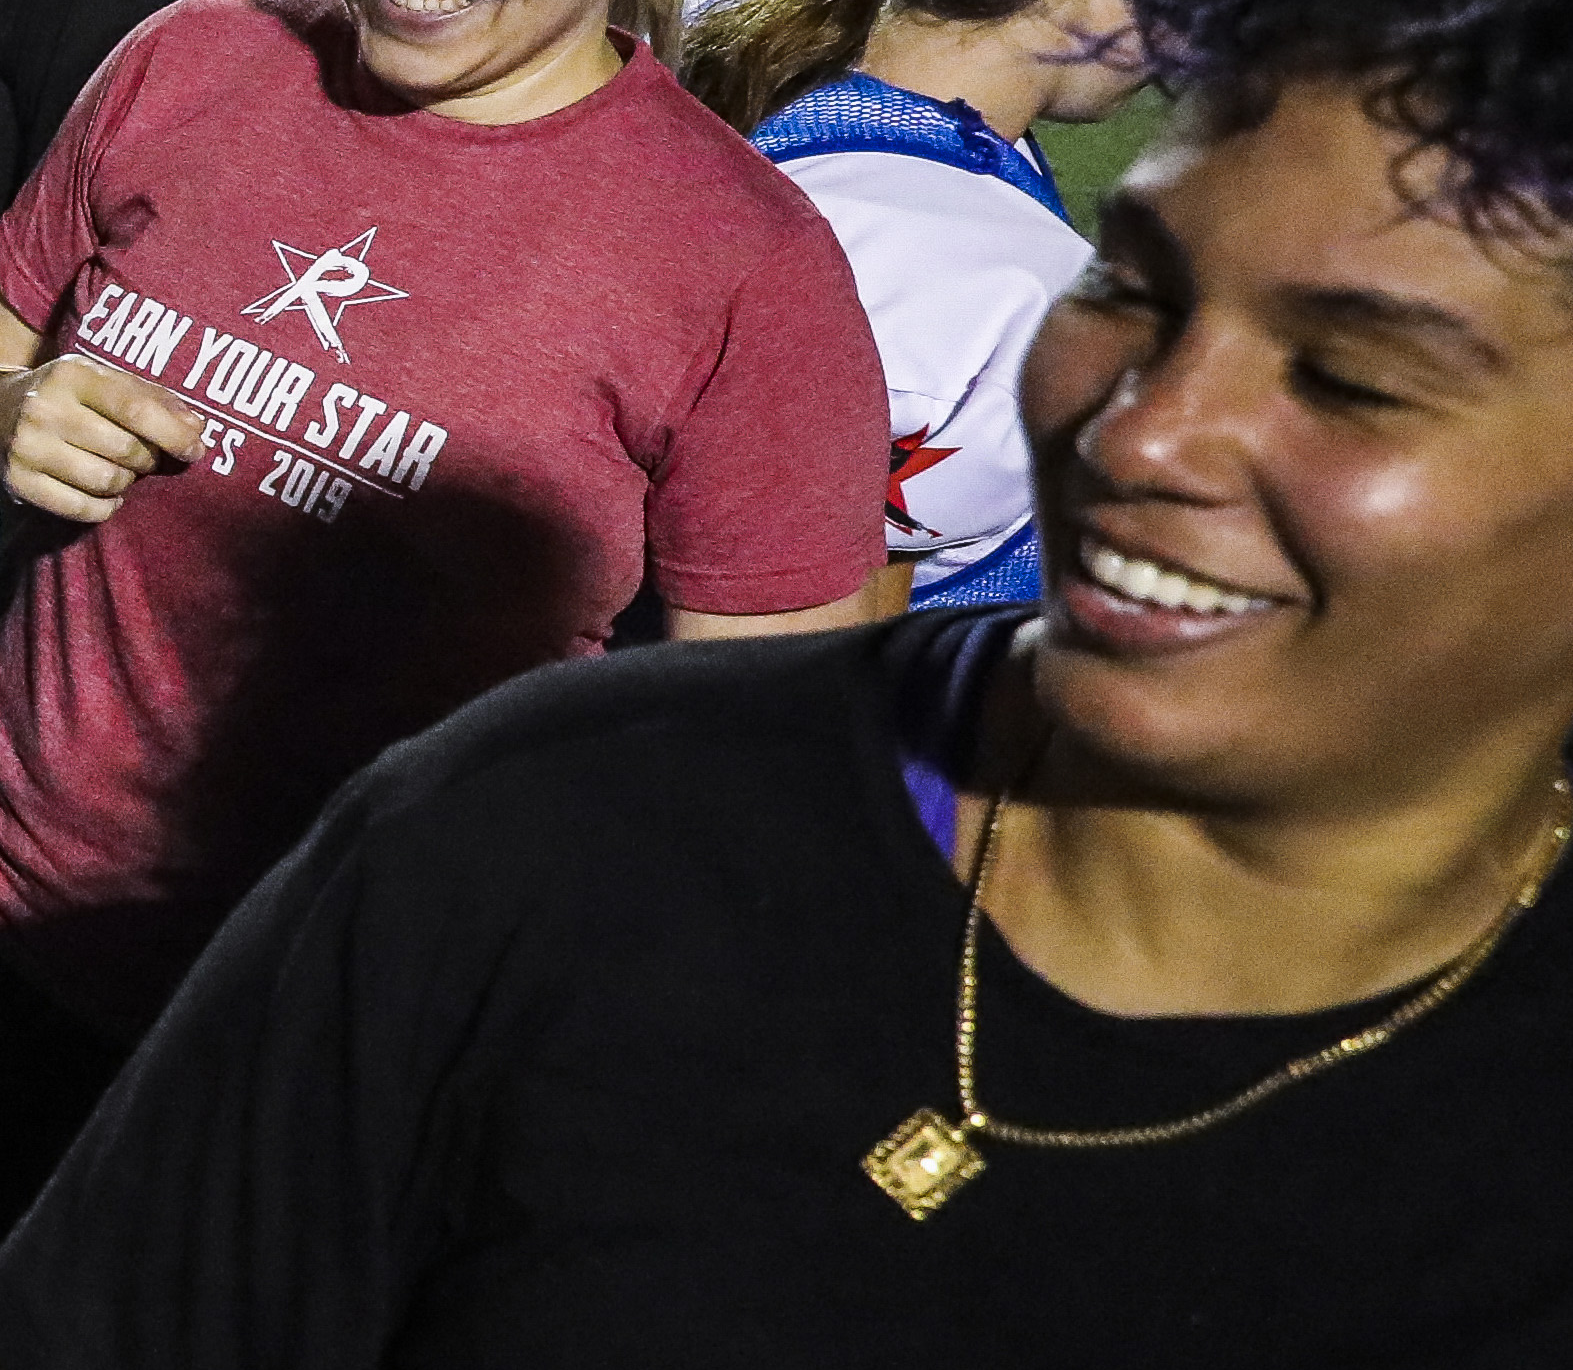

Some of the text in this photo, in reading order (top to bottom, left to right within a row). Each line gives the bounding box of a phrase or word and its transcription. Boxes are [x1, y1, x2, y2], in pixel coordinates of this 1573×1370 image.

[76, 283, 449, 493] EARN YOUR STAR
[258, 449, 353, 525] 2019
